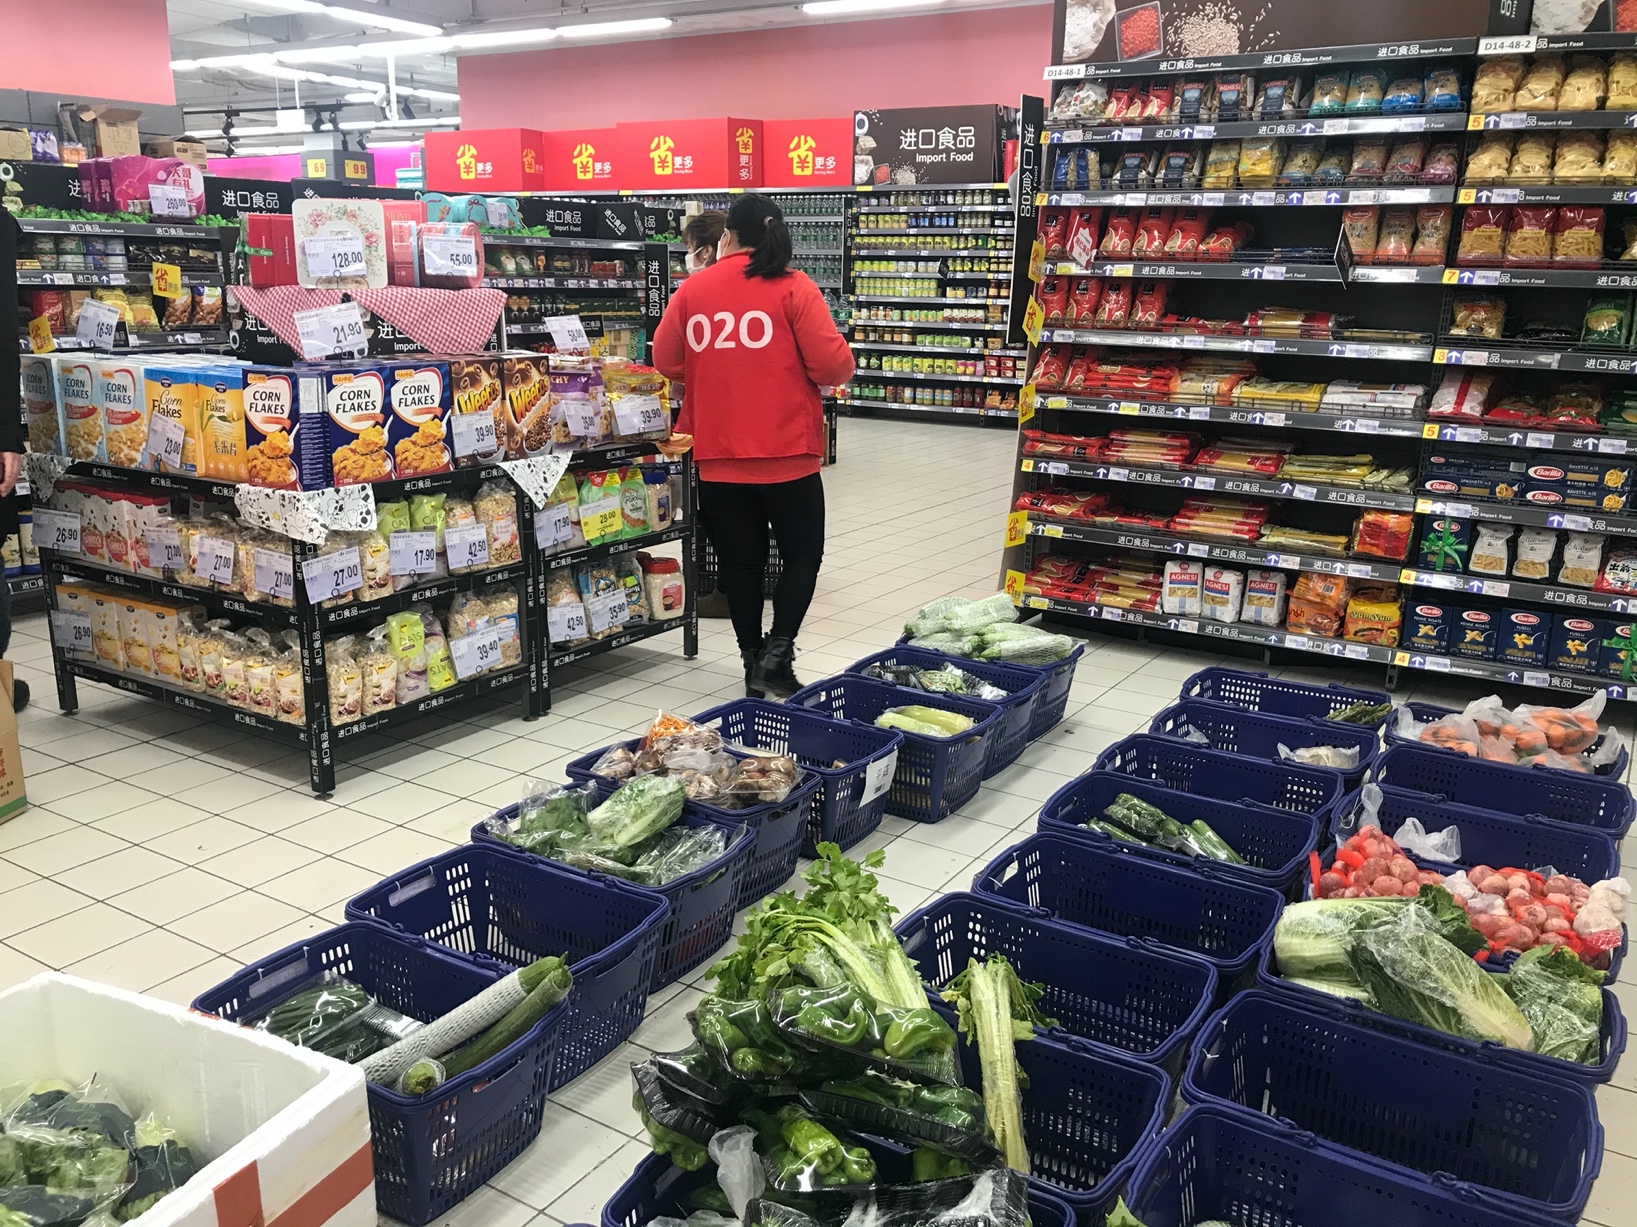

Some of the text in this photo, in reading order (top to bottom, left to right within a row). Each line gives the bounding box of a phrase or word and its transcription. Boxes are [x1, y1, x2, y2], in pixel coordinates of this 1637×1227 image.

[1377, 44, 1420, 57] 进口食品
[1484, 39, 1531, 51] D14-48-2
[1262, 53, 1301, 64] 进口食品
[1158, 59, 1194, 71] 进口食品
[1047, 68, 1081, 78] D14-48-1
[1218, 83, 1242, 91] AGNESI
[1471, 116, 1481, 128] 5
[1258, 124, 1296, 135] 进口食品
[900, 126, 976, 151] 进口食品
[1043, 132, 1050, 142] 6
[916, 151, 974, 165] Import Food
[313, 163, 325, 172] 69
[352, 164, 366, 175] 99
[221, 190, 280, 209] 进口食品
[1038, 195, 1046, 204] 7
[1147, 194, 1182, 204] 进口食品
[1463, 191, 1472, 201] 5
[546, 209, 582, 225] 进口食品
[69, 223, 100, 233] 进口食品
[155, 227, 184, 235] 进口食品
[332, 251, 363, 269] 128.00
[450, 253, 473, 267] 55.00
[1141, 266, 1175, 276] 进口食品
[1447, 271, 1456, 281] 7
[648, 260, 660, 317] 进口食品
[95, 322, 113, 338] 16.50
[333, 322, 362, 344] 21.90
[257, 334, 278, 344] Import
[1135, 336, 1168, 345] 进口食品
[394, 341, 421, 351] Import
[1438, 352, 1446, 361] 3
[1585, 358, 1631, 370] 进口食品
[66, 377, 85, 388] CORN
[107, 382, 127, 393] CORN
[64, 388, 89, 400] FLAKES
[339, 389, 371, 402] CORN
[401, 384, 431, 396] CORN
[105, 392, 132, 405] FLAKES
[159, 389, 184, 406] Corn
[210, 392, 226, 405] Corn
[252, 390, 281, 403] CORN
[398, 395, 435, 408] FLAKES
[508, 377, 550, 424] Weetos
[205, 400, 226, 413] Flakes
[249, 402, 285, 415] FLAKES
[335, 401, 377, 414] FLAKES
[640, 408, 661, 424] 39.90
[475, 424, 494, 444] 39.90
[1426, 426, 1436, 437] 5
[164, 437, 181, 455] 23.00
[606, 450, 626, 460] 进口食品
[1024, 462, 1031, 470] 4
[92, 467, 112, 478] 进口食品
[479, 468, 504, 479] 进口食品
[1128, 471, 1161, 483] 进口食品
[1535, 468, 1563, 479] Barilla
[150, 476, 172, 488] 进口食品
[403, 479, 432, 491] 进口食品
[1224, 480, 1260, 492] 进口食品
[1431, 482, 1457, 493] Barilla
[211, 485, 235, 497] 进口食品
[1328, 491, 1366, 504] 进口食品
[1534, 493, 1562, 503] Barilla
[599, 510, 616, 525] 28.00
[553, 516, 570, 534] 17.90
[55, 527, 78, 544] 26.90
[662, 531, 679, 541] 进口食品
[1117, 536, 1150, 547] 进口食品
[164, 545, 182, 561] 27.00
[468, 539, 487, 558] 42.50
[609, 542, 629, 554] 进口食品
[1211, 547, 1246, 560] 进口食品
[213, 554, 231, 572] 27.00
[414, 548, 435, 566] 17.90
[550, 556, 572, 569] 进口食品
[52, 562, 70, 573] 进口食品
[105, 573, 125, 586] 进口食品
[274, 570, 292, 589] 27.00
[333, 563, 359, 587] 27.00
[485, 570, 509, 584] 进口食品
[1171, 573, 1197, 581] AGNESI
[1404, 573, 1411, 581] 4
[162, 586, 184, 598] 进口食品
[1205, 581, 1230, 592] AGNESI
[1250, 581, 1277, 591] AGNESI
[411, 587, 438, 601] 进口食品
[1543, 590, 1587, 605] 进口食品
[223, 599, 246, 613] 进口食品
[609, 602, 626, 620] 35.90
[1421, 607, 1441, 616] Barilla
[328, 607, 358, 622] 进口食品
[1468, 612, 1488, 622] Barilla
[1516, 614, 1538, 624] Barilla
[566, 615, 584, 632] 42.50
[1569, 621, 1592, 630] Barilla
[73, 625, 91, 641] 26.90
[1204, 625, 1239, 638] 进口食品
[612, 634, 631, 648] 进口食品
[476, 640, 498, 661] 39.40
[1398, 655, 1406, 663] 4
[118, 679, 138, 692] 进口食品
[490, 673, 514, 688] 进口食品
[174, 696, 195, 709] 进口食品
[418, 695, 444, 712] 进口食品
[234, 713, 256, 726] 进口食品
[337, 721, 367, 738] 进口食品
